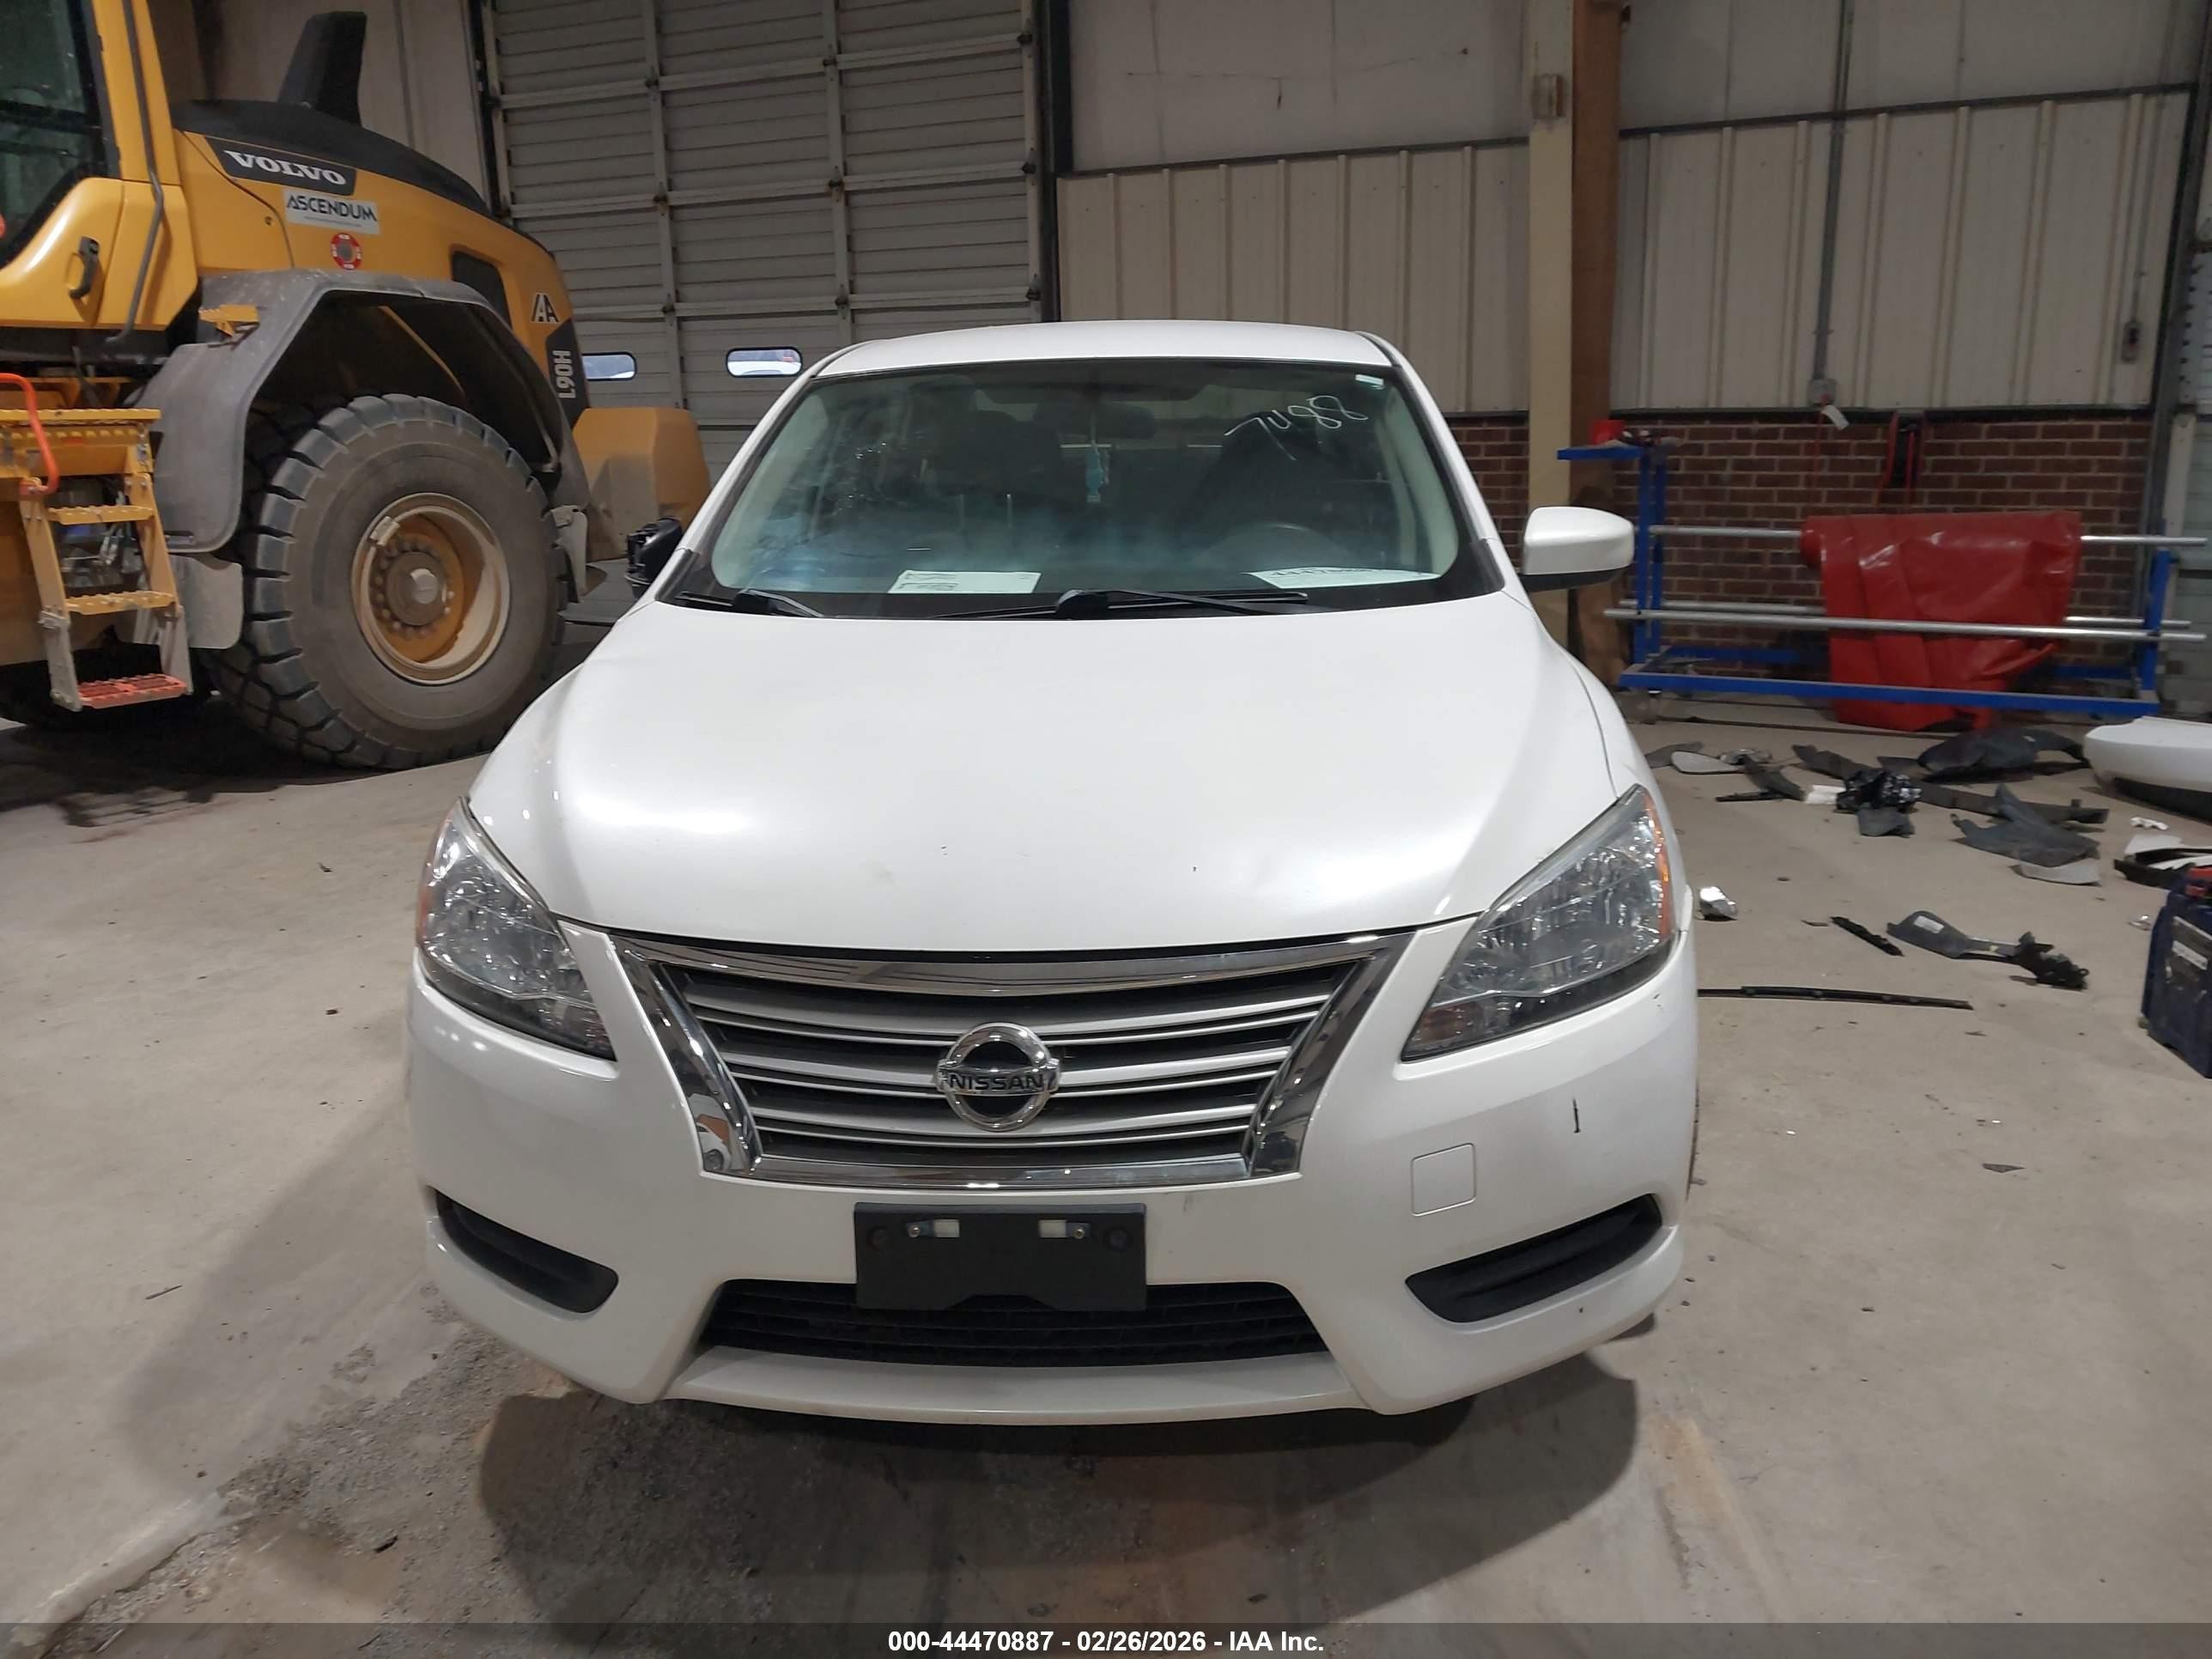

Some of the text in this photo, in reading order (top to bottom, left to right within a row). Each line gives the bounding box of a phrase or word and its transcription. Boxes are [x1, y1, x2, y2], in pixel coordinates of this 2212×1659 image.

[223, 149, 347, 185] VOLVO
[285, 193, 378, 222] ASCENDUM
[552, 349, 577, 399] L90H
[949, 1072, 1045, 1091] NISSAN
